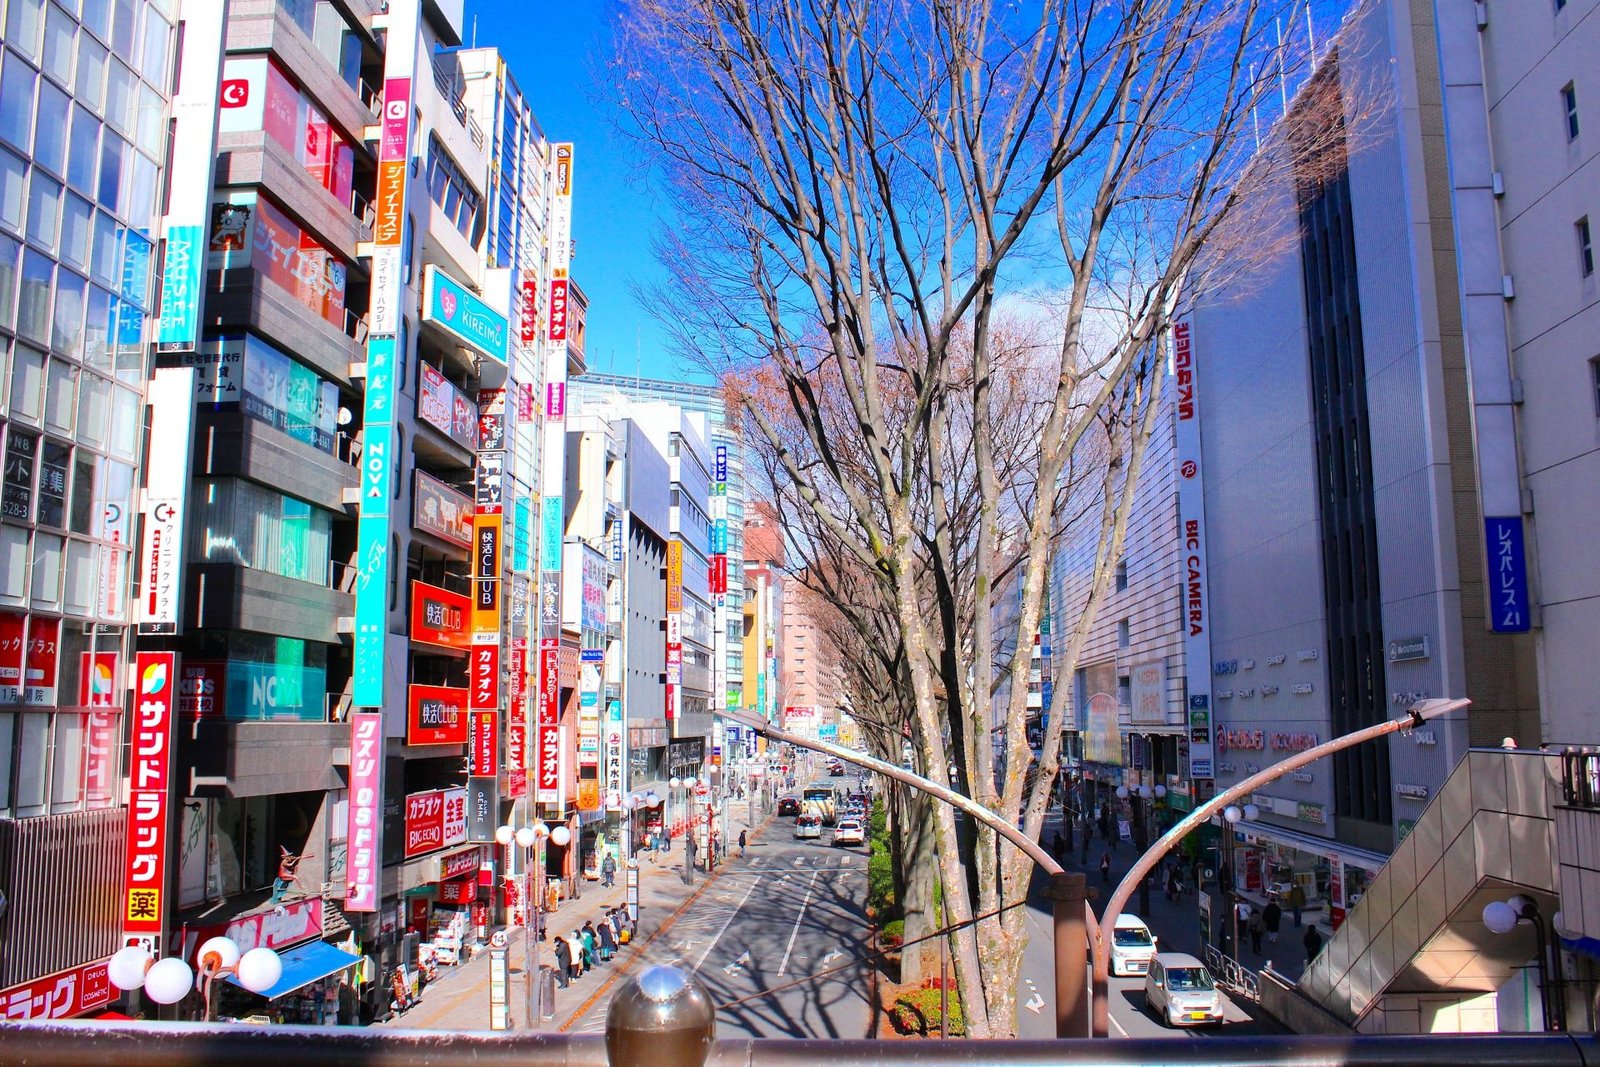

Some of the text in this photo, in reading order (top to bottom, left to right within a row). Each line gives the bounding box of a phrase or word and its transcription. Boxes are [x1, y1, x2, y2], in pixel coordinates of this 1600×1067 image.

[382, 165, 405, 241] ジェイエステ
[161, 241, 175, 329] PLATINUM
[174, 241, 191, 328] MUSEE
[462, 310, 502, 347] KIREIMO
[553, 286, 565, 336] カラオケ
[171, 342, 181, 351] 5F
[1174, 321, 1194, 421] ビックカメラ
[484, 439, 498, 449] 6F
[367, 442, 384, 498] NOVA
[484, 505, 495, 514] 5F
[160, 524, 173, 619] クリニックプラス
[357, 538, 387, 591] エイブル
[481, 531, 493, 606] 快活CLUB
[1186, 519, 1203, 637] BIC CAMERA
[1498, 524, 1521, 626] レオパレス21
[151, 623, 161, 632] 3F
[427, 602, 461, 630] 快活CLUB
[478, 650, 492, 704] カラオケ
[423, 703, 459, 724] 快活CLUB
[356, 720, 377, 778] クスリ
[482, 723, 491, 774] サンドラッグ
[543, 730, 557, 786] カラオケ
[131, 700, 166, 883] サンドラッグ
[410, 796, 442, 821] カラオケ
[446, 797, 465, 824] 全室
[351, 786, 375, 904] OSドラッグ
[409, 825, 441, 849] BIG ECHO
[445, 824, 465, 840] DAM
[129, 891, 156, 919] 薬
[443, 883, 459, 900] 薬
[492, 933, 505, 945] 14
[83, 987, 108, 1002] COSMETIC
[87, 969, 107, 981] DRUG
